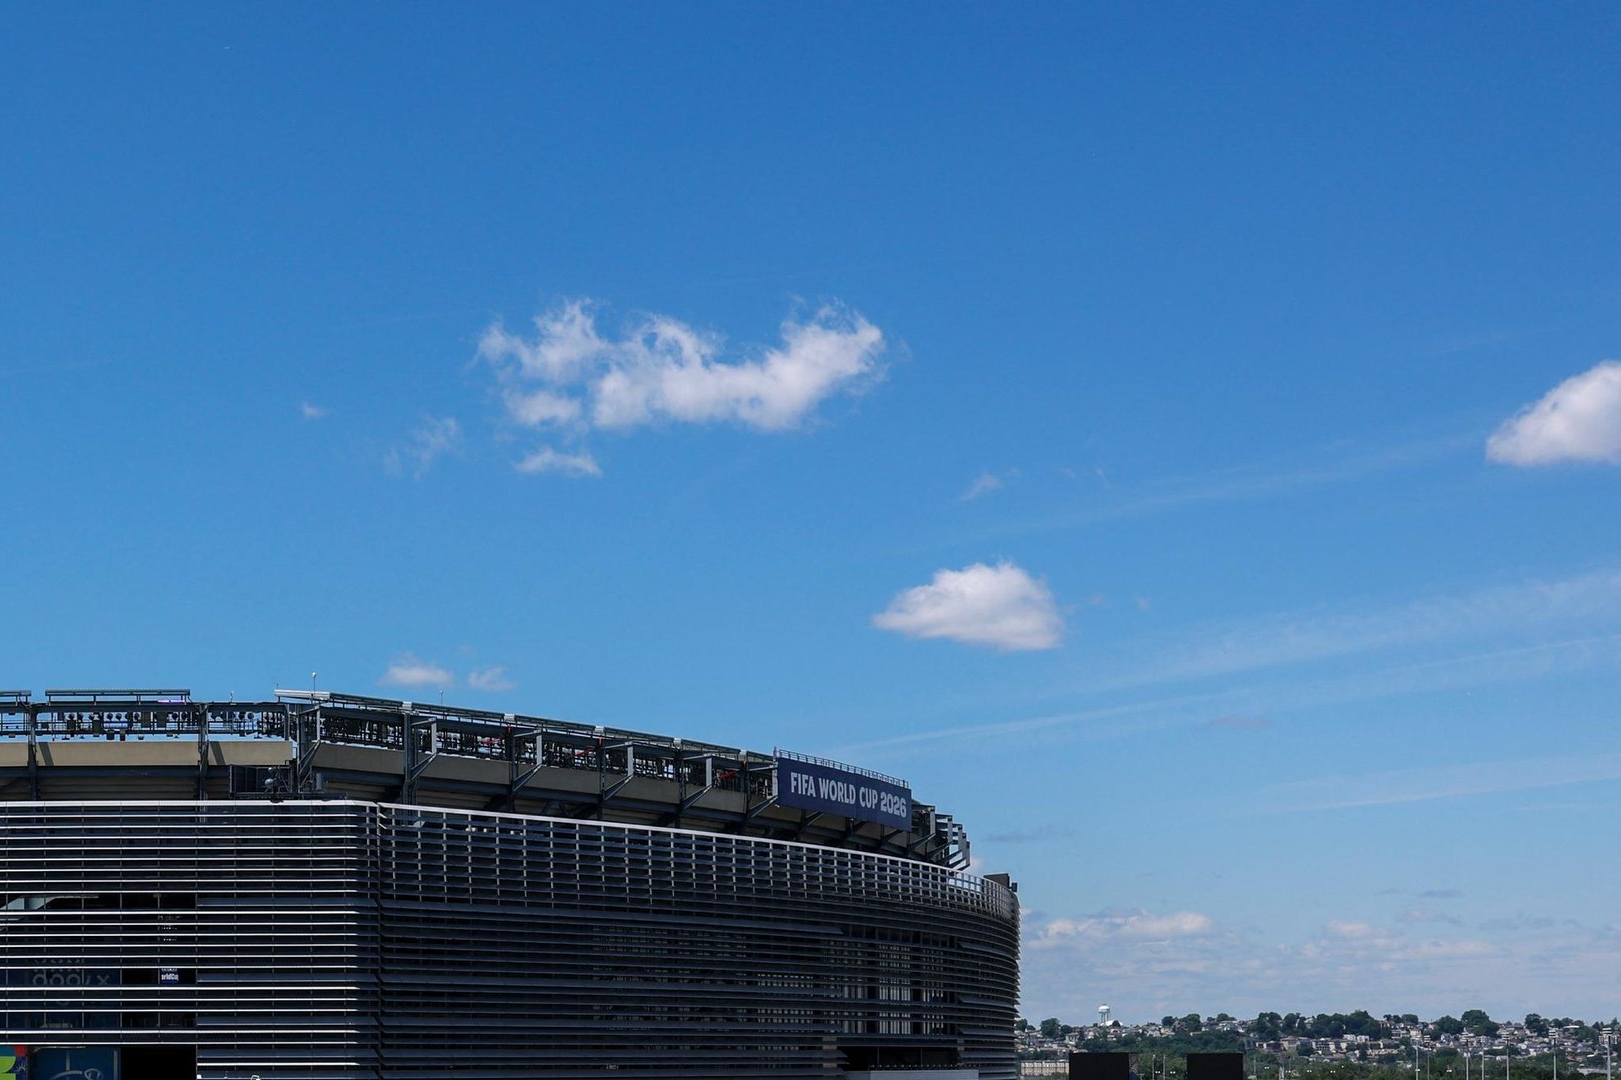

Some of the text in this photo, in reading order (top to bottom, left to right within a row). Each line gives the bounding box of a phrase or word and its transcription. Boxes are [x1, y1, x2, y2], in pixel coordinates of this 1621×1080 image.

[790, 771, 907, 818] FIFA WORLD CUP 2026
